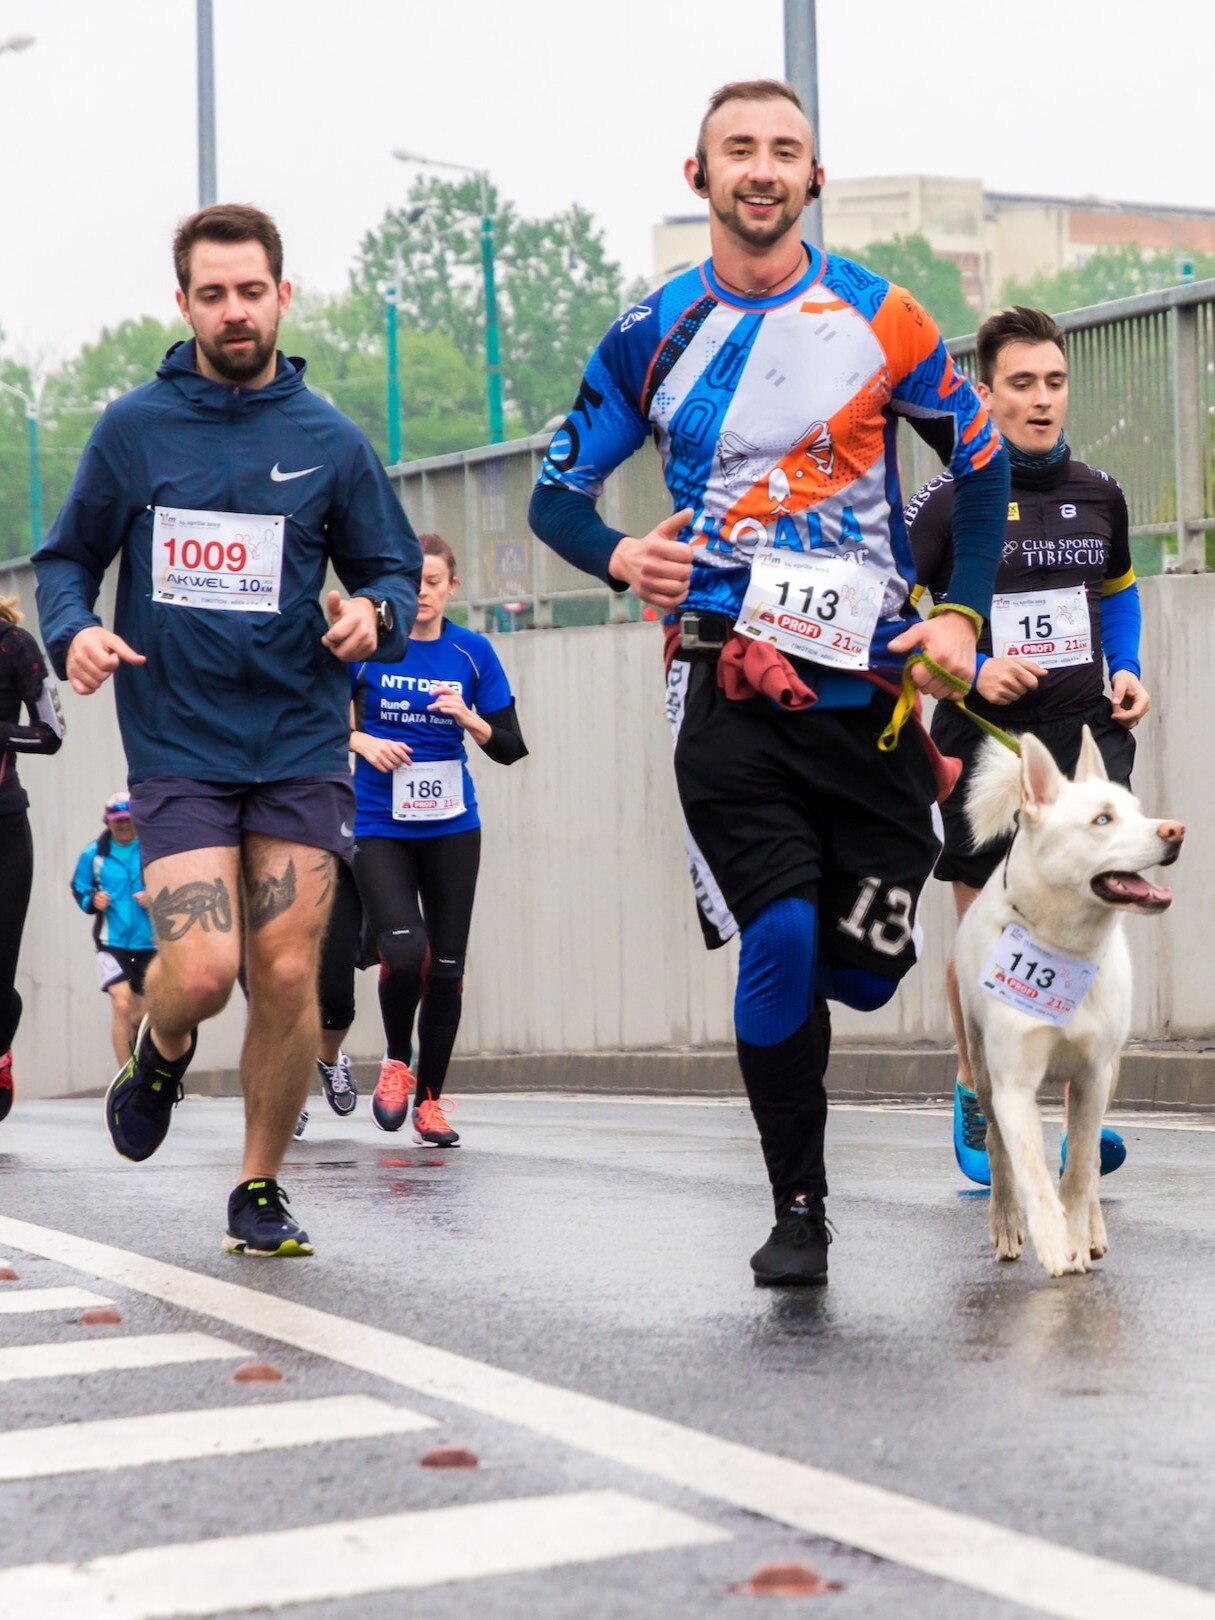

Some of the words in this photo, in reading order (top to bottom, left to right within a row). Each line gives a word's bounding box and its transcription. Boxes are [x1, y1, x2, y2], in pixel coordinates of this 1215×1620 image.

[903, 472, 955, 527] IBISCU
[703, 507, 864, 554] KOALA
[1022, 540, 1055, 550] CLUB
[1058, 538, 1103, 549] SPORTIV
[163, 537, 247, 572] 1009
[1022, 550, 1105, 566] TIBISCUS
[166, 573, 230, 589] AKWEL
[775, 581, 840, 621] 113
[780, 617, 819, 638] PROFI
[1018, 614, 1053, 640] 15
[1022, 645, 1052, 654] PROFI
[381, 674, 416, 690] NTT
[380, 699, 411, 711] Run@
[380, 711, 399, 721] NTT
[401, 714, 427, 723] DATA
[429, 716, 453, 725] Team
[406, 780, 442, 798] 186
[837, 876, 912, 956] 13
[1010, 952, 1056, 989] 113
